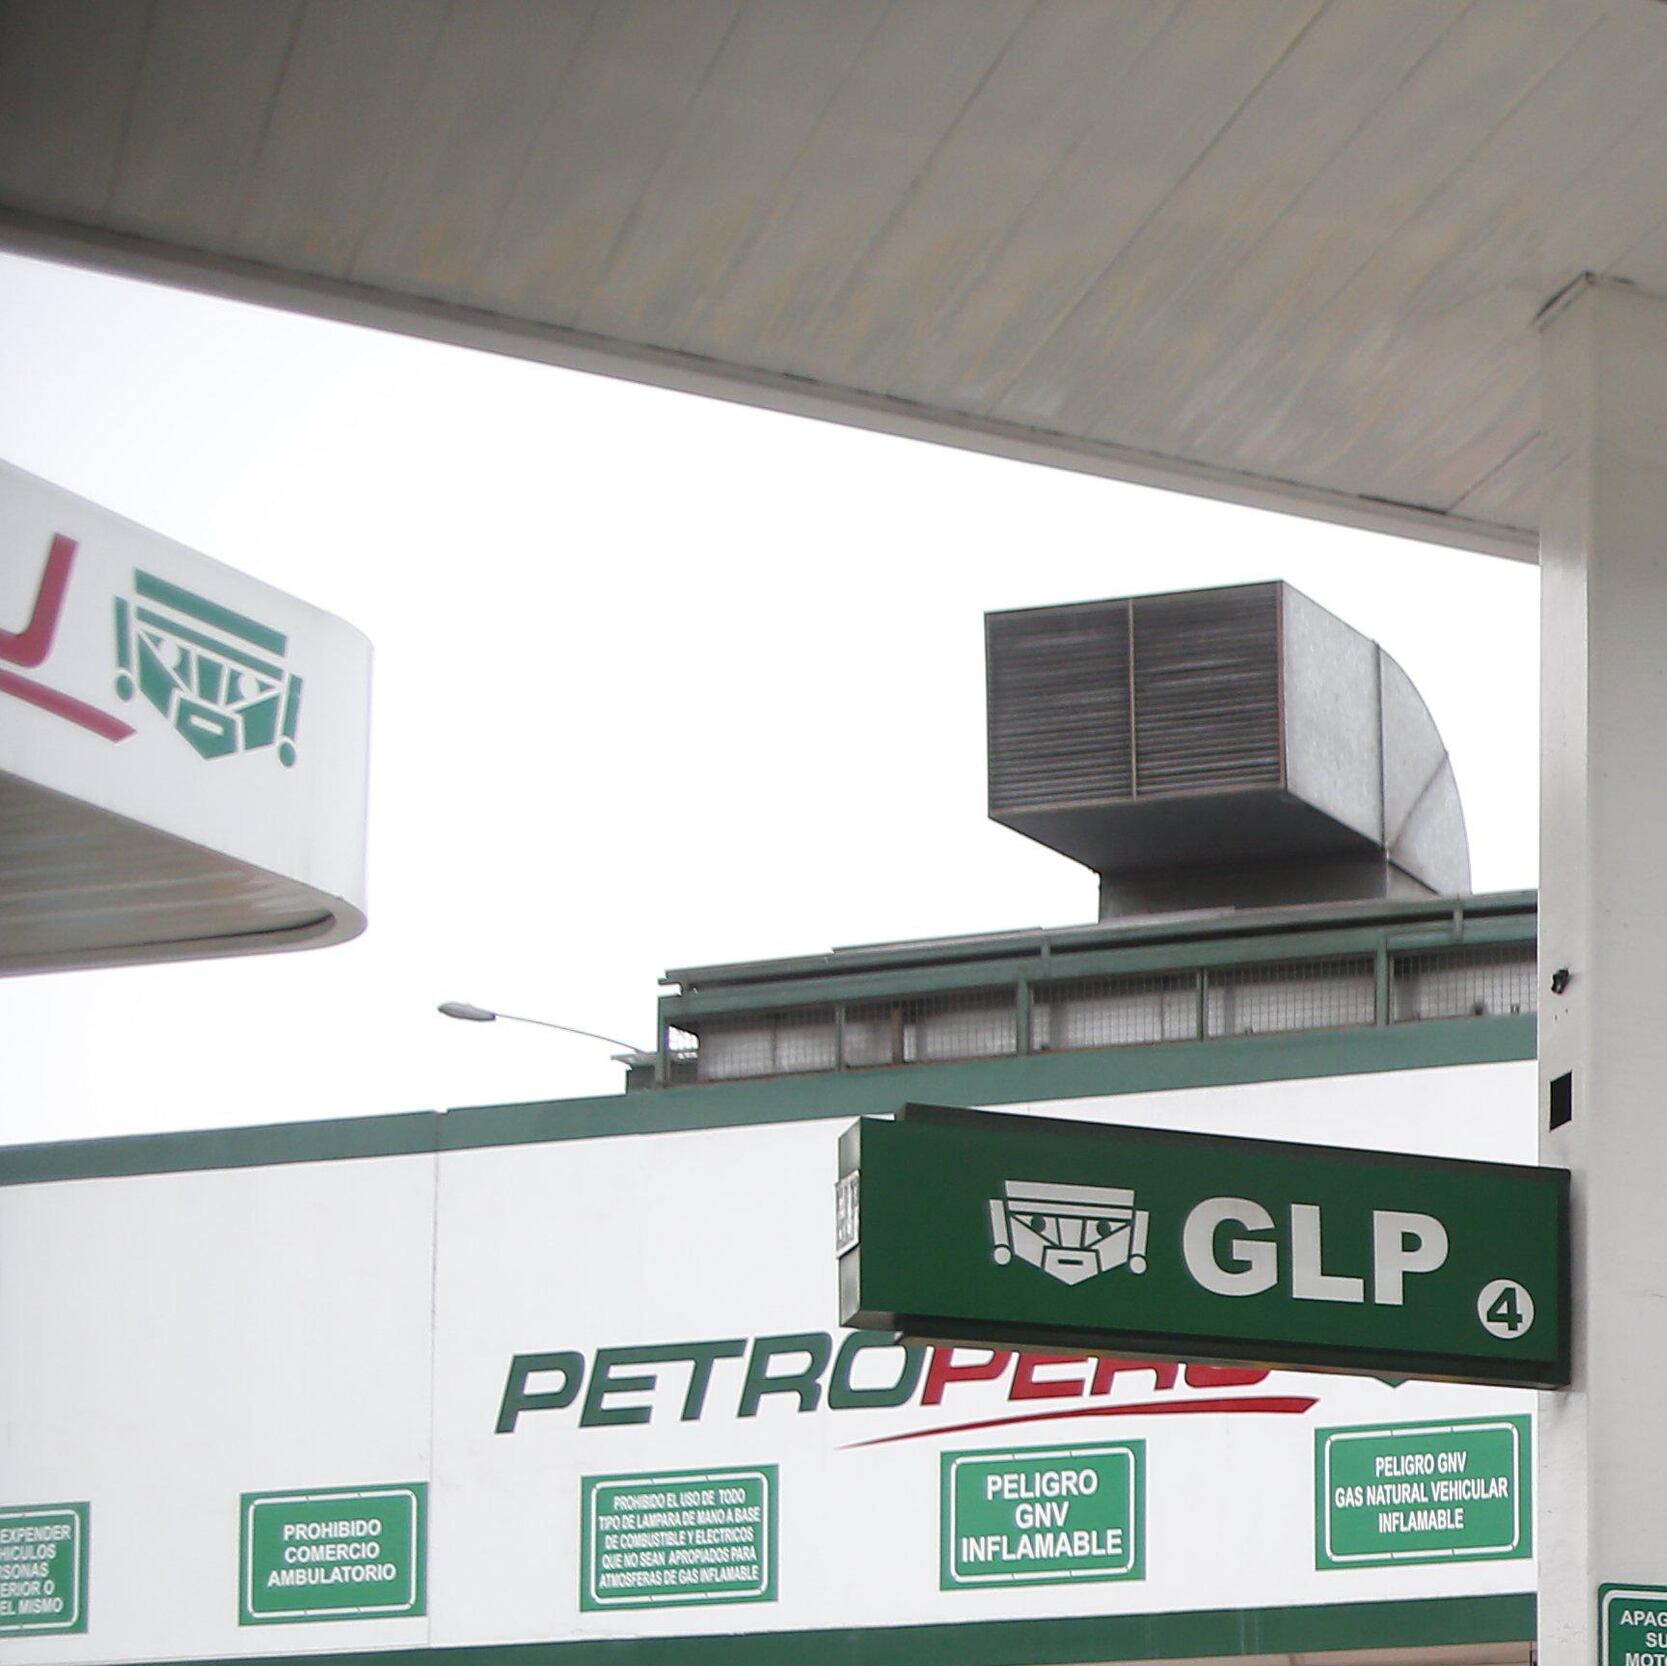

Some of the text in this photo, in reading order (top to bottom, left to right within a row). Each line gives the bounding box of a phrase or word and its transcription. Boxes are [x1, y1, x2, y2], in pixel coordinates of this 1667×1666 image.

[1182, 1197, 1524, 1332] GLP 4
[1375, 1451, 1466, 1477] PELIGRO GNV
[719, 1488, 745, 1505] TODO
[986, 1468, 1098, 1500] PELIGRO
[1335, 1477, 1508, 1508] GAS NATURAL VEHICULAR
[734, 1507, 761, 1523] BASE
[1015, 1501, 1069, 1529] GNV
[1379, 1508, 1464, 1533] INFLAMABLE
[283, 1519, 382, 1541] PROHIBIDO
[605, 1534, 619, 1550] DE
[284, 1541, 380, 1563] COMERCIO
[731, 1546, 757, 1562] PARA
[961, 1529, 1122, 1562] INFLAMABLE
[267, 1563, 396, 1588] AMBULATORIO
[678, 1568, 699, 1585] GAS
